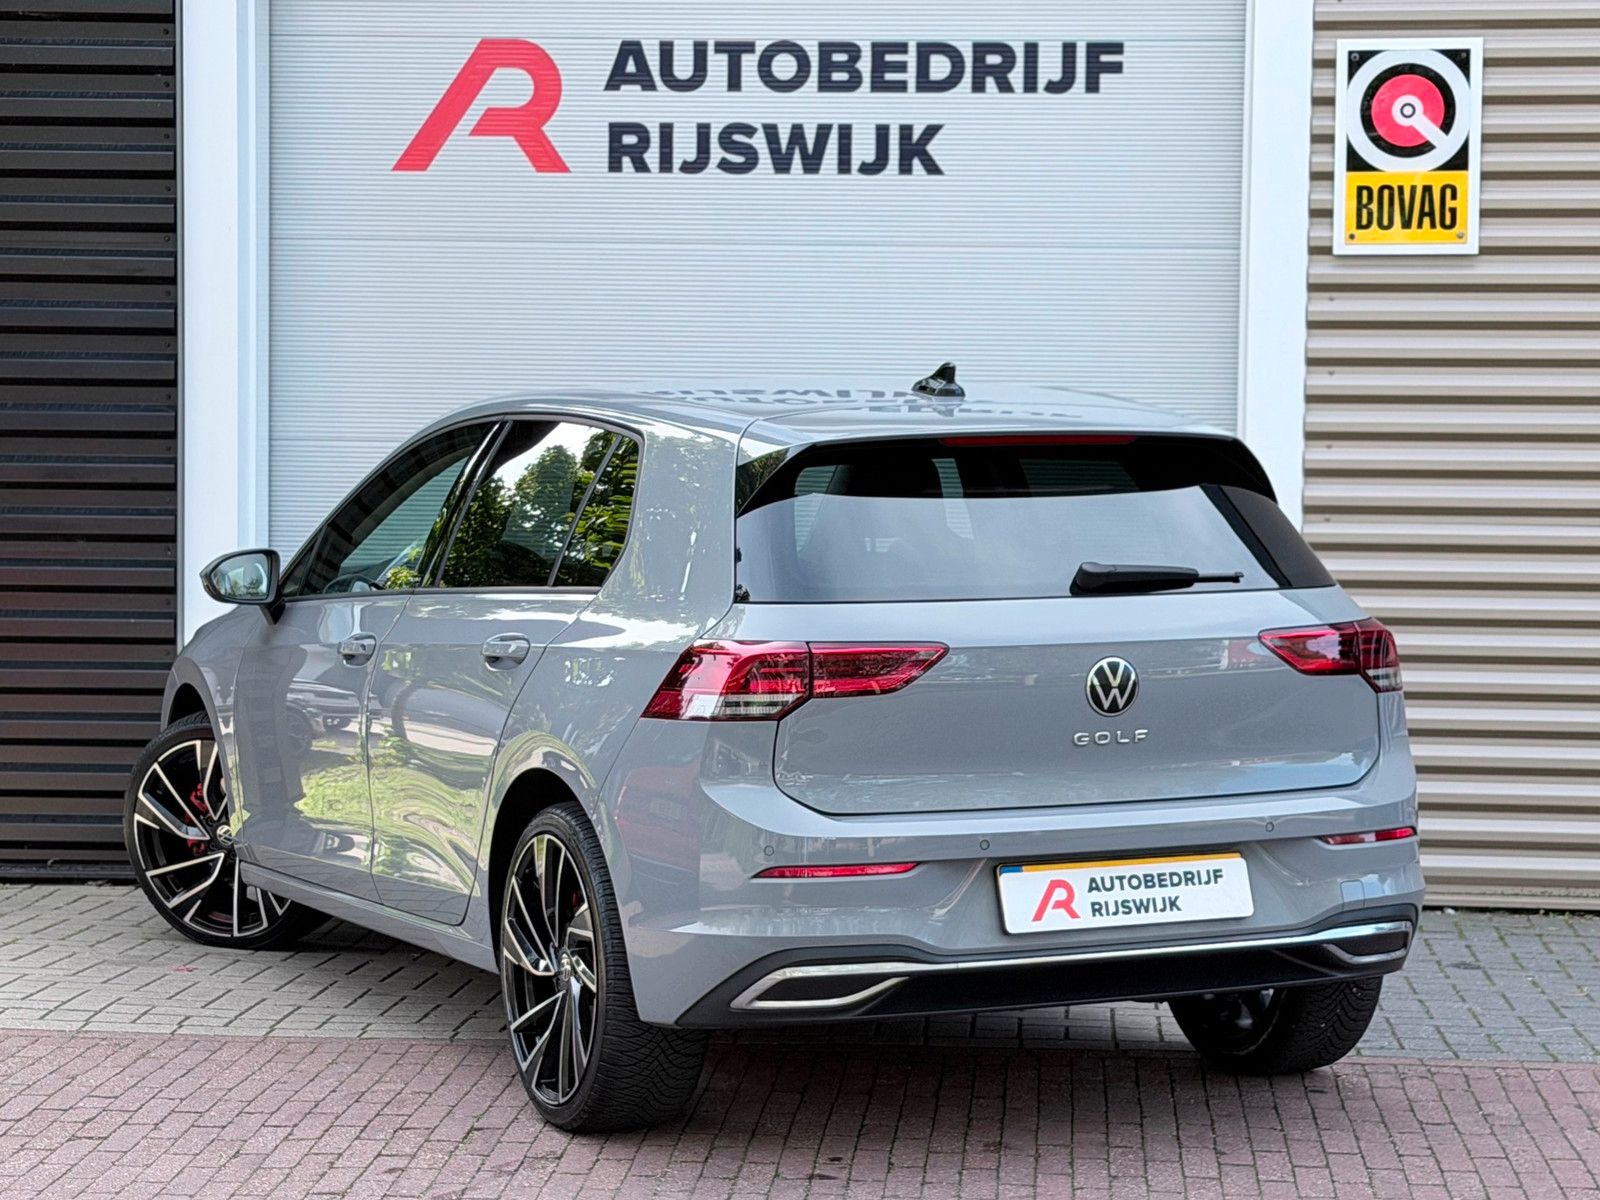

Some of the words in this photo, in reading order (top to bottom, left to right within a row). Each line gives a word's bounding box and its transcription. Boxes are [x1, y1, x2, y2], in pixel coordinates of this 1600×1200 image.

[604, 40, 1124, 94] AUTOBEDRIJF
[607, 122, 946, 175] RIJSWIJK
[1355, 183, 1458, 231] BOVAG
[1073, 729, 1149, 746] GOLF
[1087, 868, 1224, 893] AUTOBEDRIJF
[1090, 896, 1182, 918] RIJSWIJK
